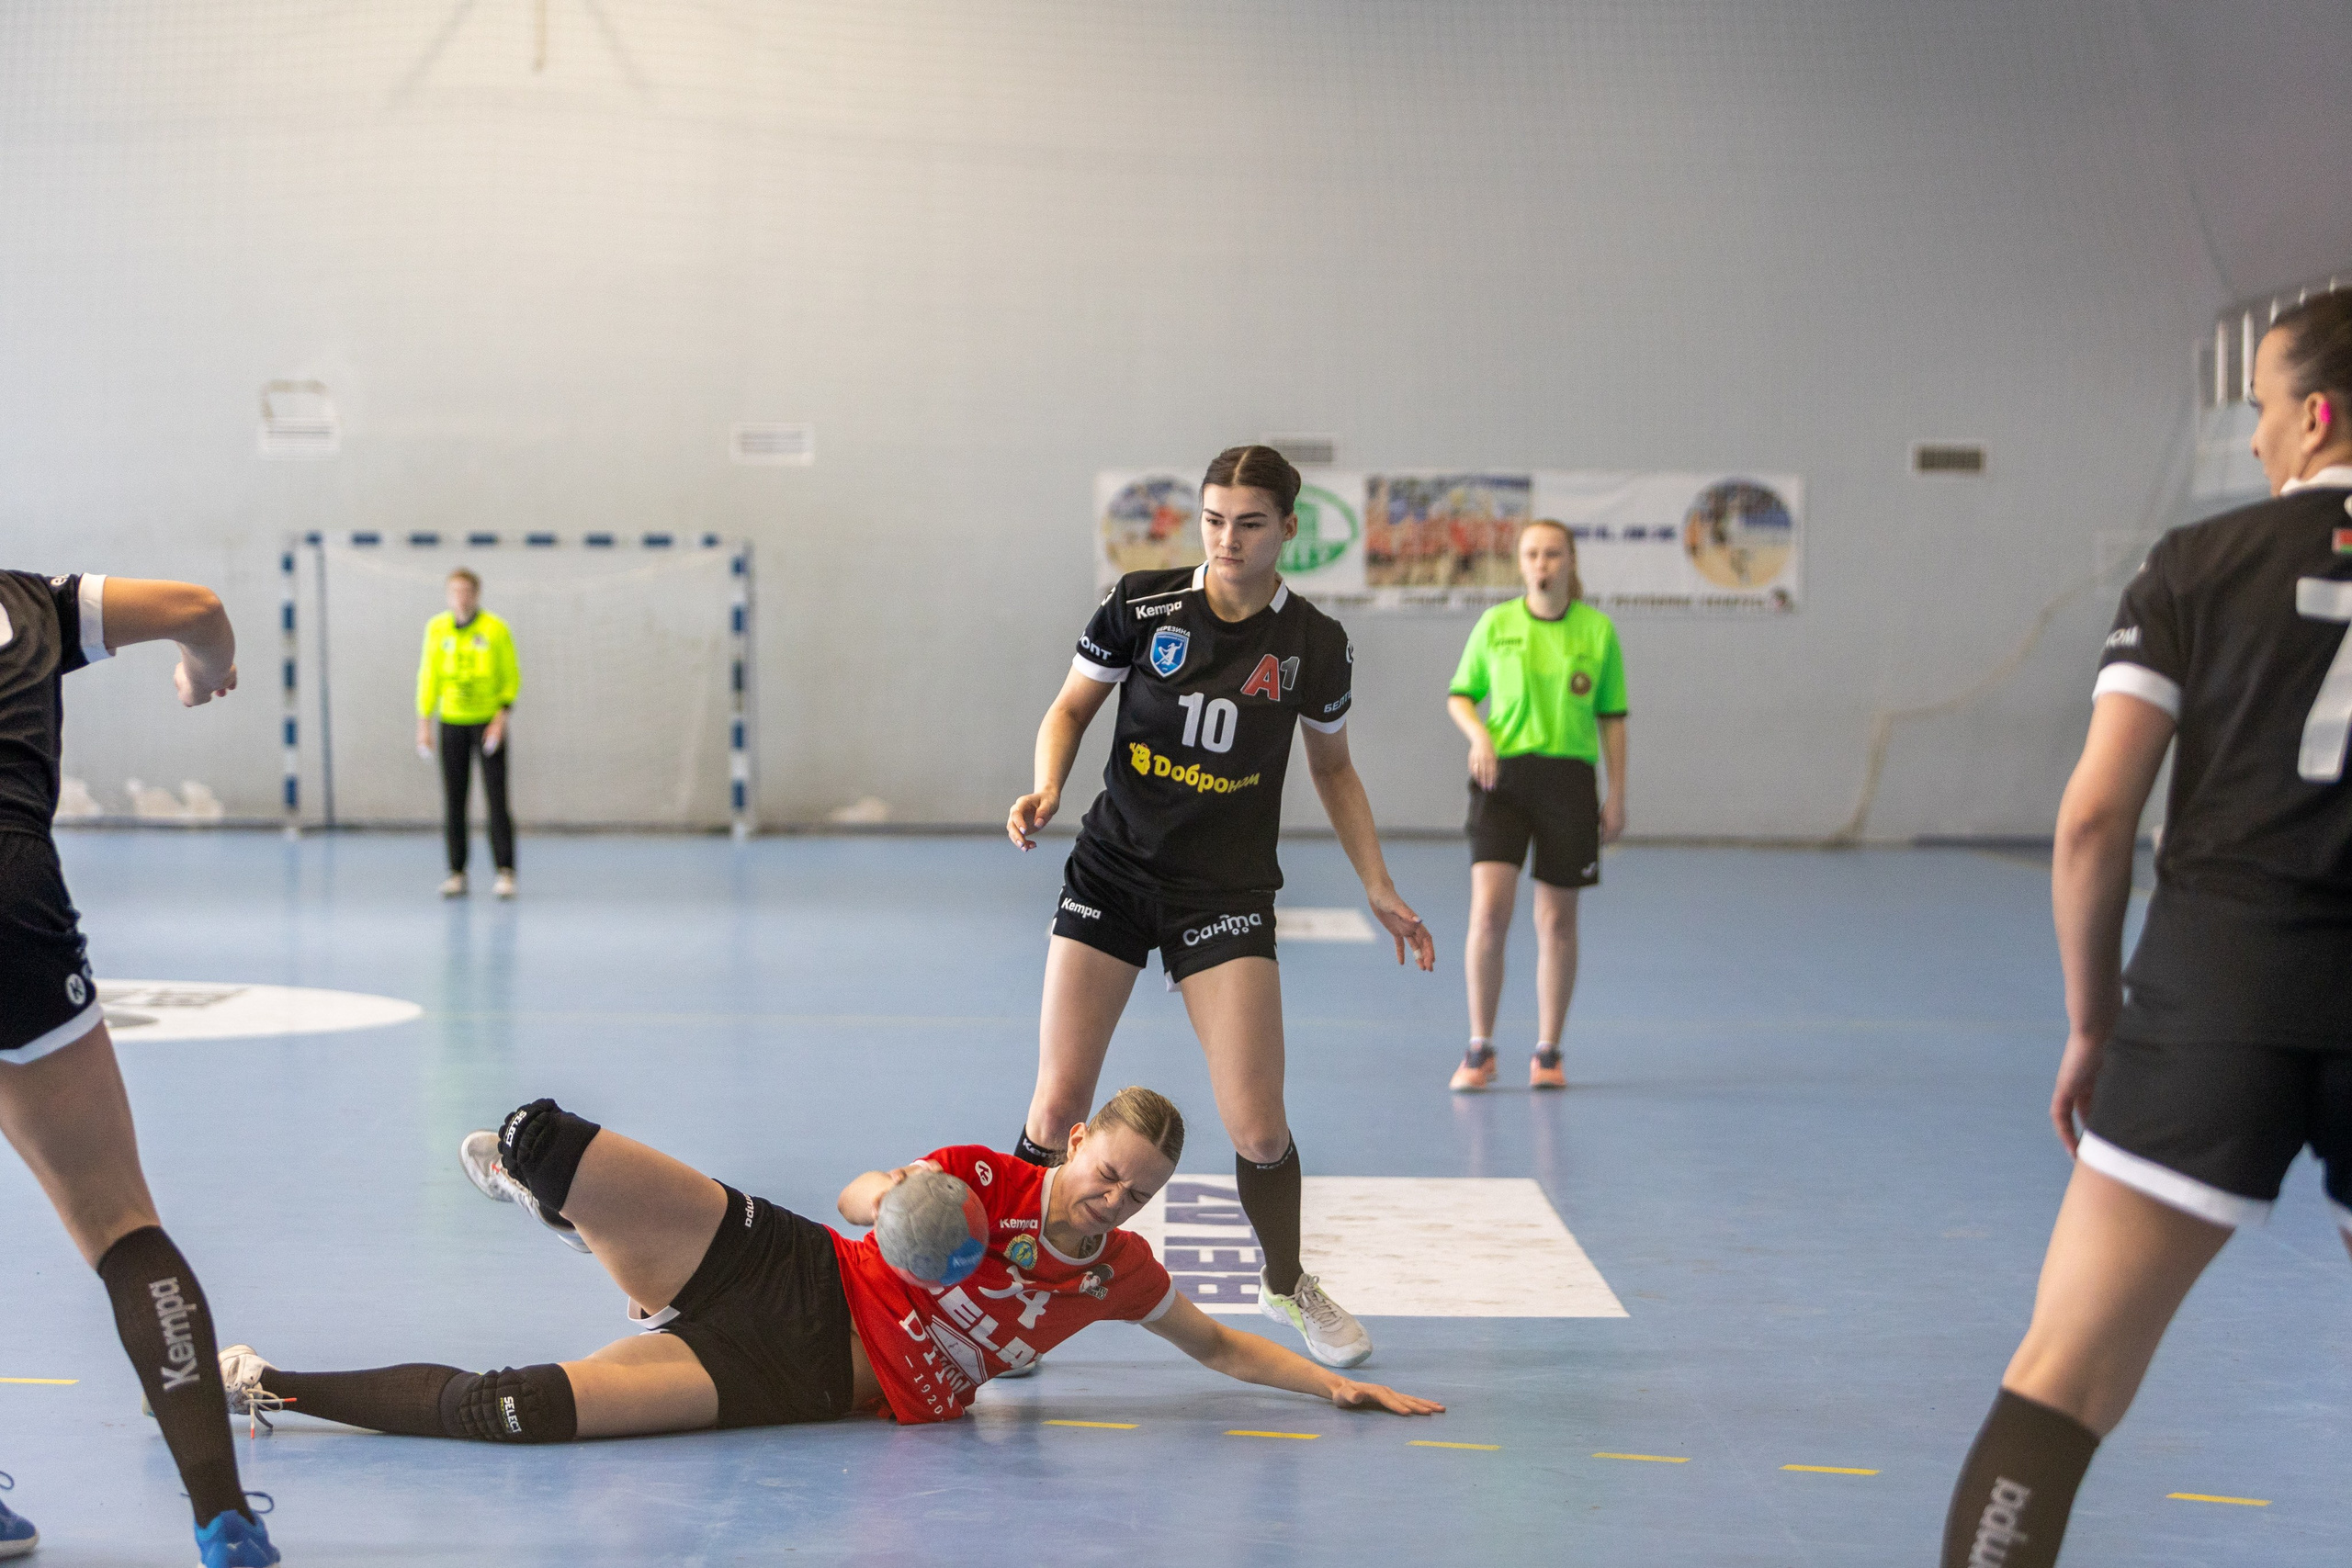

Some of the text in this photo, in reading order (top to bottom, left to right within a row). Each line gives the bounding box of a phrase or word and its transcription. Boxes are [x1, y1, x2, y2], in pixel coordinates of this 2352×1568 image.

[1135, 600, 1182, 620] Kempa
[1079, 630, 1112, 660] ОПТ
[1240, 653, 1300, 702] A1
[1178, 692, 1238, 752] 10
[1061, 897, 1102, 919] Kempa
[505, 1110, 527, 1147] SELECT
[743, 1193, 754, 1228] mpa
[999, 1218, 1038, 1231] Kempa
[148, 1276, 201, 1390] Kempa
[503, 1395, 522, 1433] SELECT
